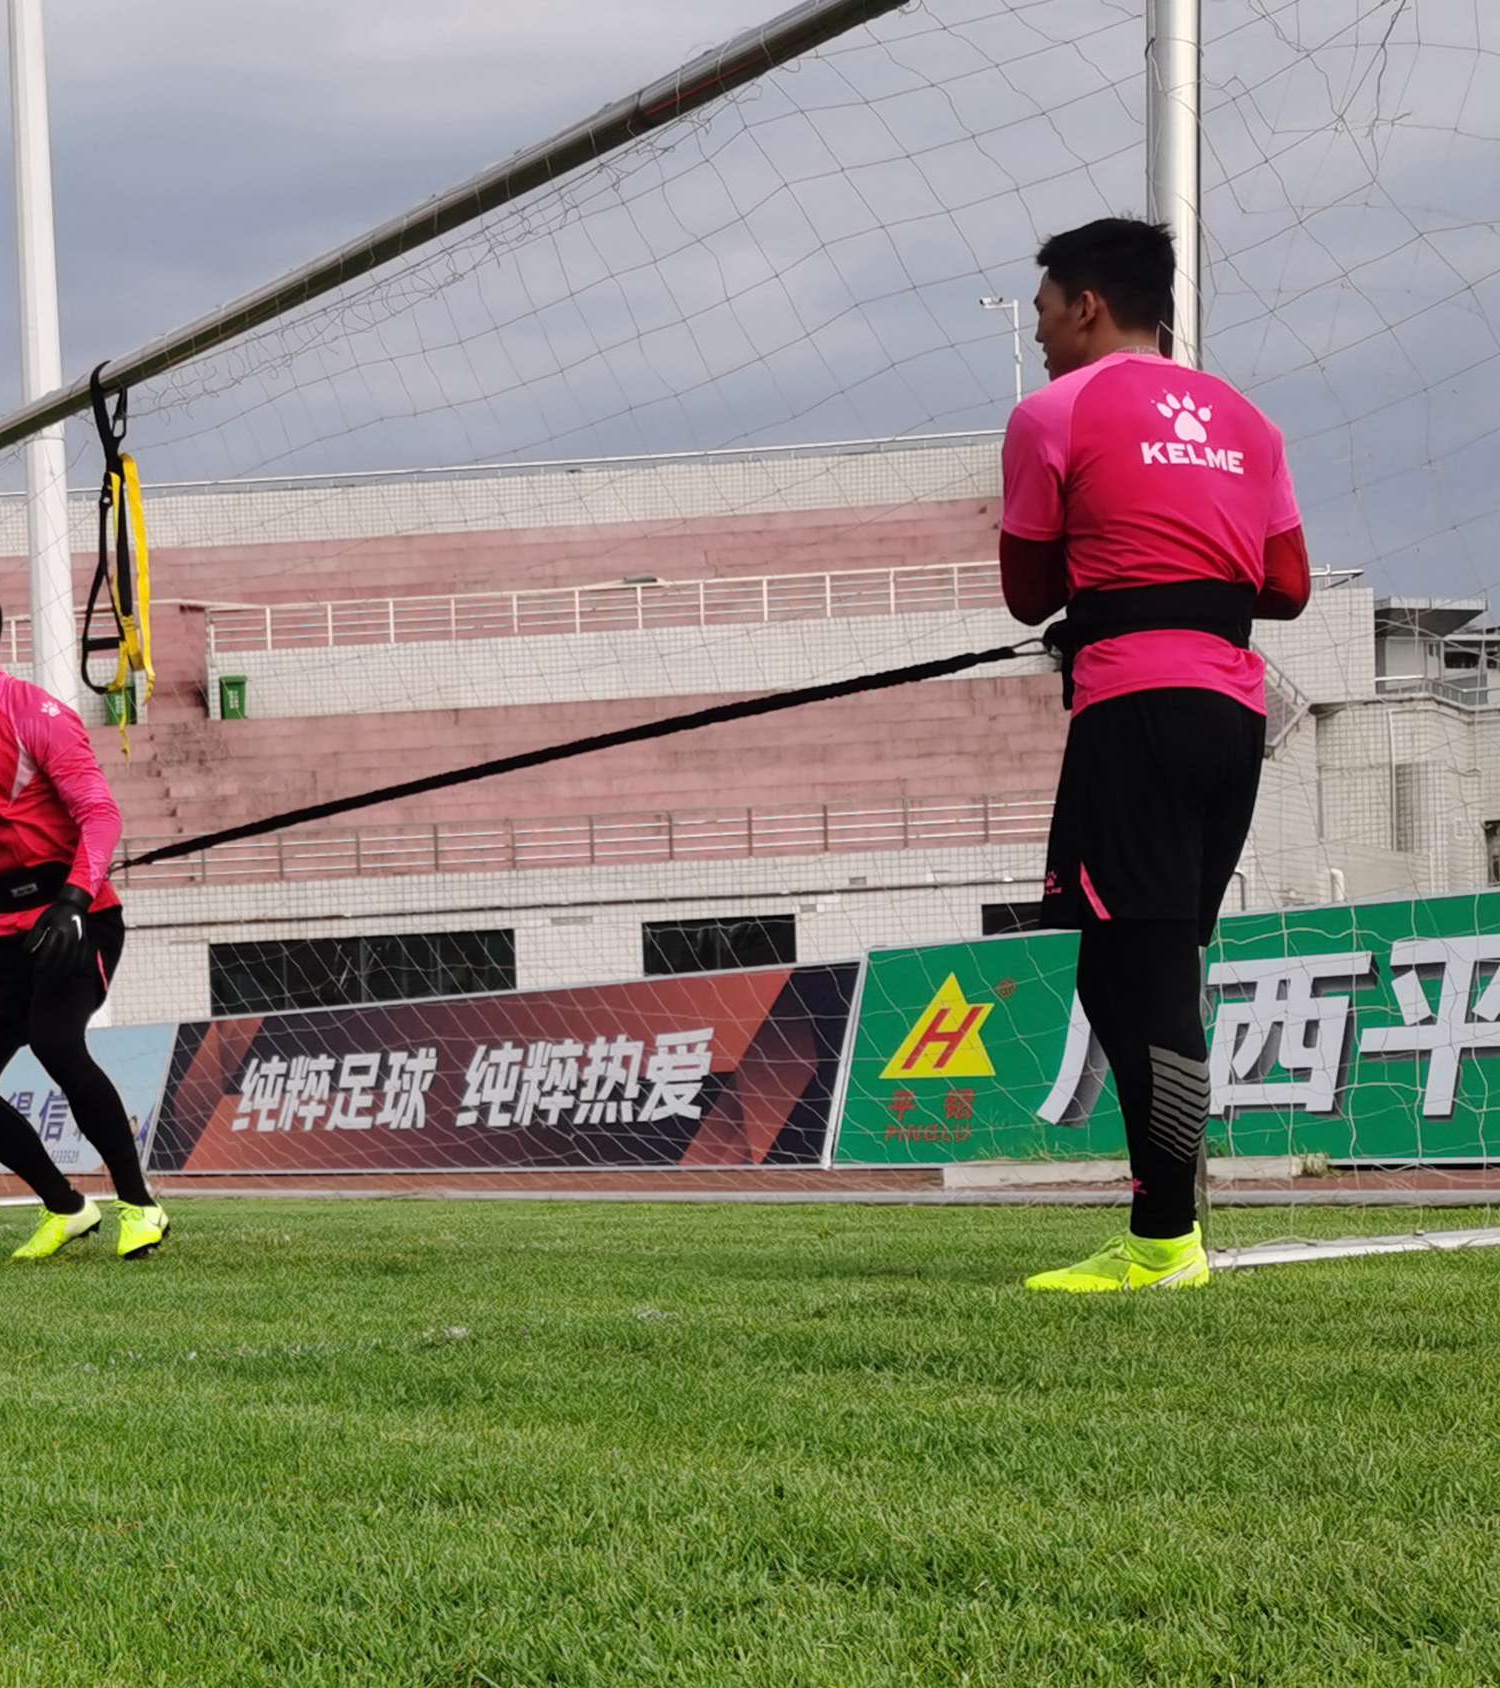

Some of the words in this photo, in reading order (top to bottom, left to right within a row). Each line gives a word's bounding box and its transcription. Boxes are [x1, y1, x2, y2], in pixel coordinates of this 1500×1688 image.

[1141, 442, 1244, 475] KELME
[232, 1047, 438, 1132] 纯粹足球
[455, 1027, 714, 1128] 纯粹热爱
